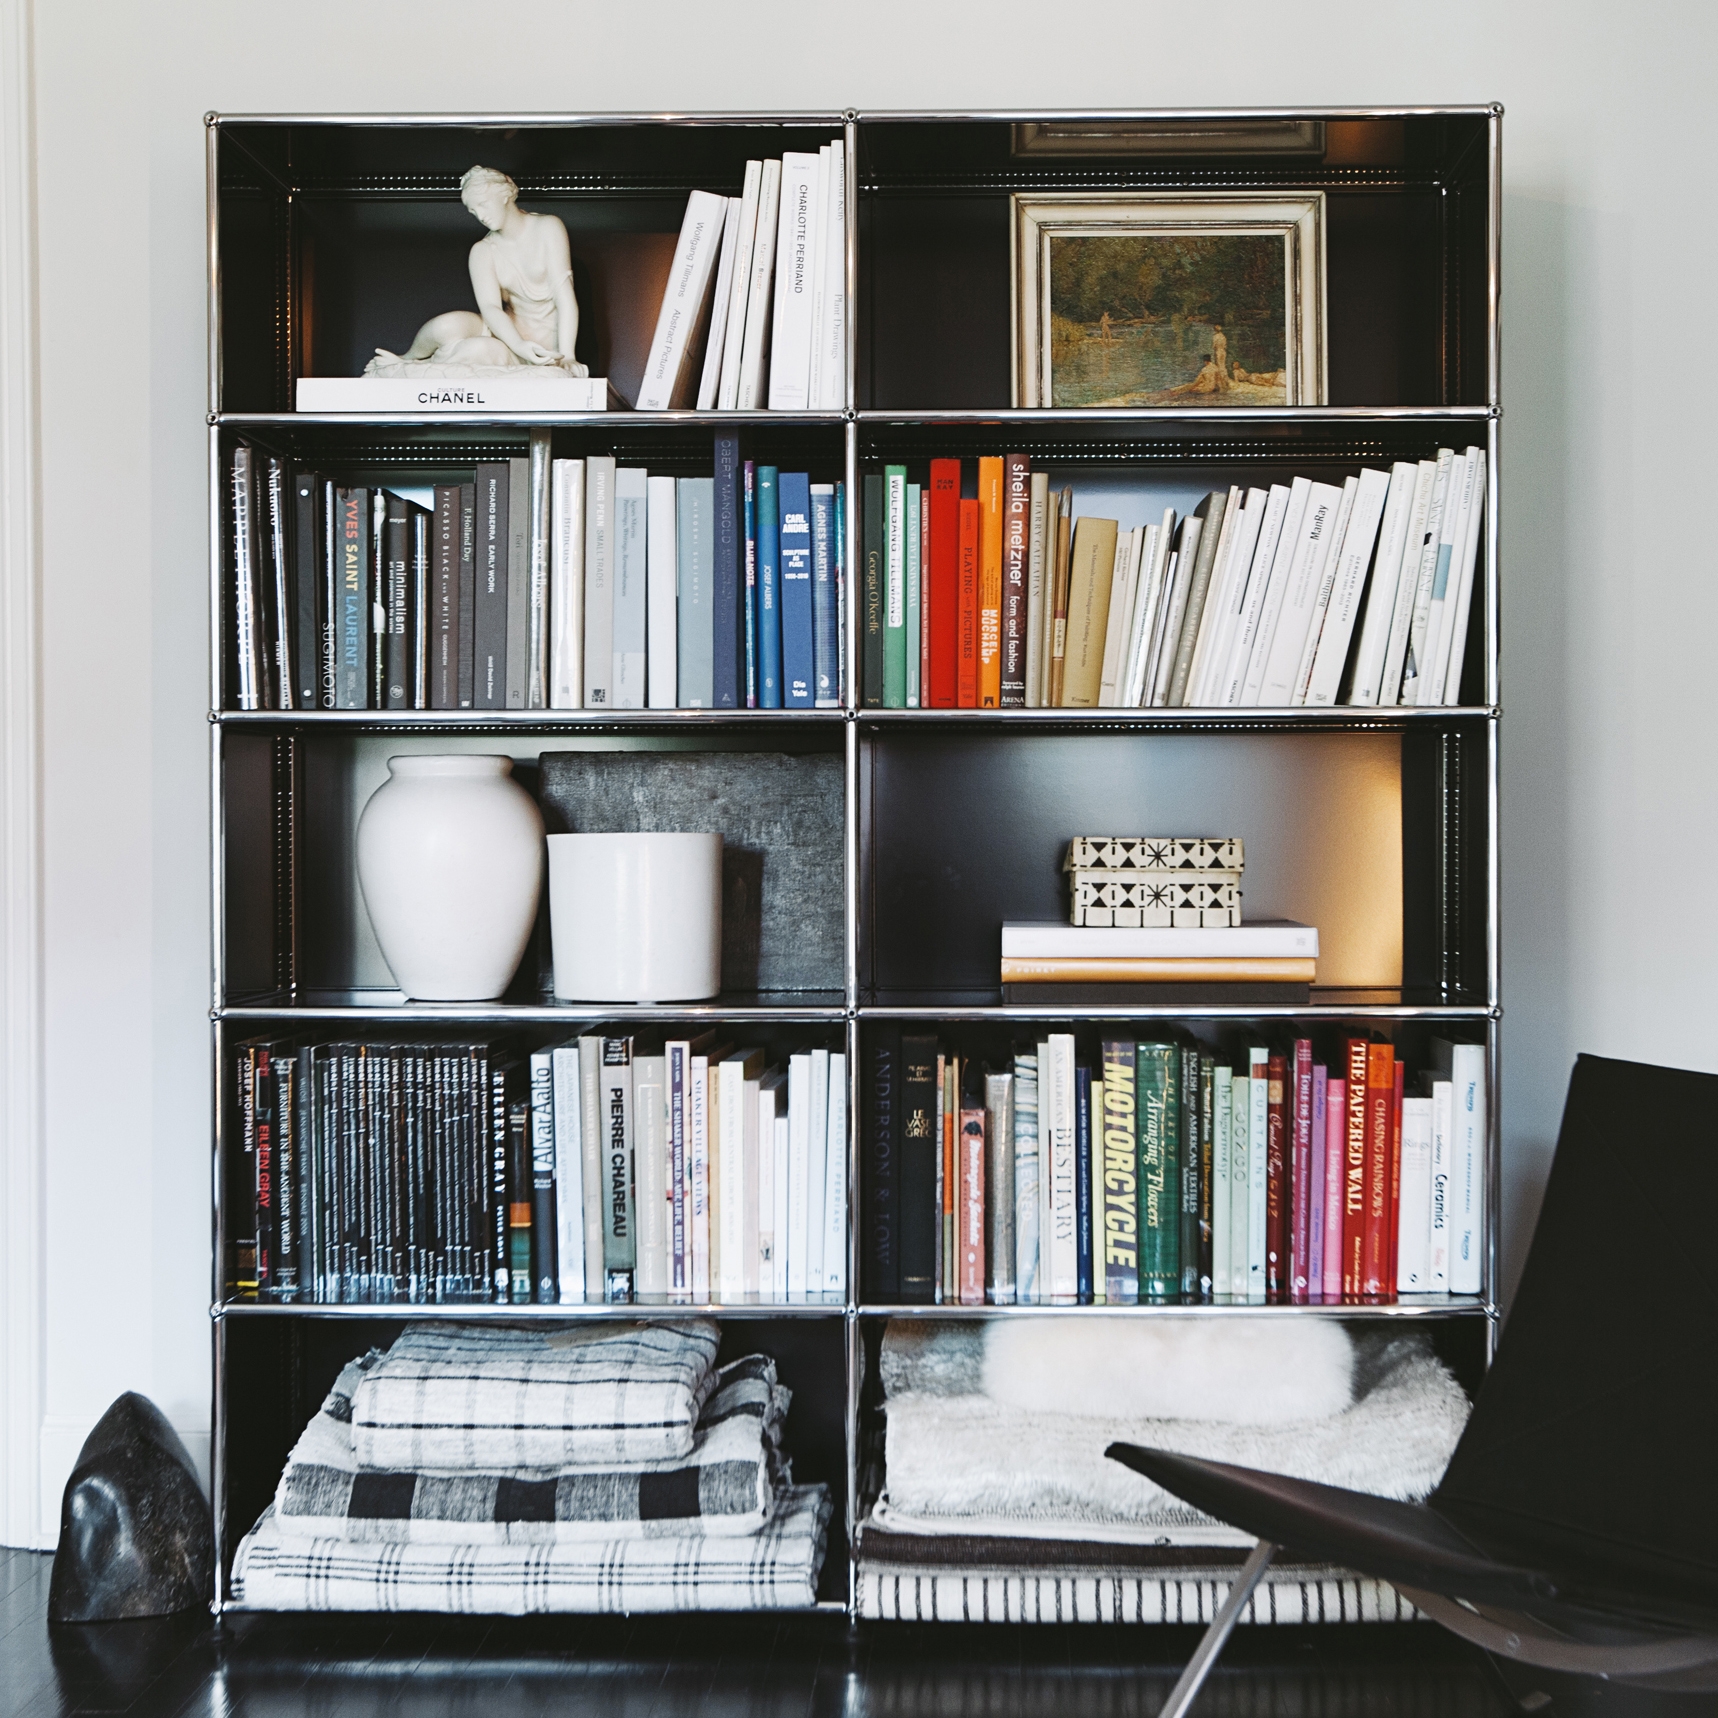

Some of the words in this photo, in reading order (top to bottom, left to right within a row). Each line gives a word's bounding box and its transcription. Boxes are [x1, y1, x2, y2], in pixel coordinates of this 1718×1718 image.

[797, 184, 808, 241] CHARLOTTE
[686, 222, 705, 261] Wolfgang
[677, 264, 694, 298] Tillmans
[794, 244, 805, 294] PERRIAND
[833, 294, 843, 316] Plant
[665, 309, 681, 344] Abstract
[831, 318, 842, 359] Drawings
[656, 346, 672, 380] Pictures
[417, 392, 485, 404] CHANEL
[1437, 453, 1451, 482] YVES
[268, 469, 281, 525] Nukuoro
[596, 472, 605, 501] IRVING
[1012, 464, 1029, 512] sheila
[1419, 473, 1431, 500] Chichu
[345, 500, 358, 538] YVES
[442, 492, 450, 540] PICASSO
[596, 504, 604, 527] PENN
[785, 514, 807, 523] CARL
[817, 505, 826, 539] AGNES
[891, 479, 901, 551] WOLFGANG
[1034, 501, 1042, 536] HARRY
[1271, 498, 1281, 521] HELMUT
[1416, 502, 1426, 515] Art
[1429, 498, 1444, 526] SAINT
[464, 516, 472, 546] Holland
[488, 515, 496, 540] SERRA
[782, 523, 809, 534] ANDRE
[909, 520, 917, 559] LAURENT
[1265, 522, 1276, 548] NEWTON
[1411, 517, 1424, 551] Museum
[345, 544, 358, 590] SAINT
[463, 547, 471, 561] Day
[746, 541, 754, 561] BLUE
[818, 542, 827, 581] MARTIN
[1010, 521, 1024, 586] metzner
[1033, 540, 1041, 597] CALLAHAN
[487, 569, 495, 593] WORK
[746, 563, 754, 585] NOTE
[868, 551, 878, 589] Georgia
[909, 562, 917, 585] SAINT
[963, 547, 972, 593] PLAYING
[1349, 556, 1361, 589] GERHARD
[1419, 550, 1438, 594] LAURENT
[395, 561, 406, 634] minimalism
[764, 586, 772, 609] ALBERS
[890, 558, 901, 624] TILLMANS
[909, 587, 917, 607] YVES
[1009, 596, 1020, 616] form
[1251, 600, 1258, 609] us
[1318, 575, 1332, 607] Balthus
[1341, 593, 1353, 622] RICHTER
[345, 596, 357, 667] LAURENT
[963, 610, 972, 658] PICTURES
[989, 610, 997, 655] MARCEL
[1008, 619, 1019, 637] and
[1242, 625, 1253, 644] them
[1247, 610, 1255, 624] and
[981, 610, 990, 664] DUCHAMP
[322, 623, 335, 707] SUGIMOTO
[1007, 640, 1019, 672] fashion
[1001, 696, 1024, 704] ARENA
[1229, 680, 1238, 703] TASCHEN
[244, 1057, 252, 1091] JOSEF
[1055, 1051, 1063, 1065] AN
[1189, 1052, 1198, 1091] ENGLISH
[1351, 1043, 1366, 1081] THE
[557, 1054, 565, 1117] ARCHITECTURE
[566, 1069, 574, 1111] JAPANESE
[694, 1080, 702, 1126] SHAKER
[1055, 1068, 1064, 1124] AMERICAN
[1221, 1082, 1231, 1102] The
[1301, 1073, 1311, 1101] TOILE
[244, 1095, 252, 1152] HOFFMANN
[279, 1082, 289, 1135] FURNITURE
[493, 1077, 504, 1141] EILEEN
[611, 1088, 624, 1149] PIERRE
[874, 1047, 890, 1177] ANDERSON
[906, 1118, 932, 1128] VASE
[912, 1109, 924, 1118] LE
[1301, 1104, 1309, 1117] DE
[1348, 1084, 1365, 1165] PAPERED
[1373, 1099, 1386, 1153] CHASING
[279, 1138, 288, 1150] IN
[567, 1113, 575, 1143] HOUSE
[835, 1099, 844, 1167] CHARLOTTE
[904, 1128, 932, 1138] GREC
[1143, 1091, 1163, 1165] Arranging
[1189, 1113, 1198, 1167] AMERICAN
[1217, 1106, 1230, 1181] Daguerreotype
[1255, 1085, 1264, 1189] CURTAINS
[1298, 1120, 1310, 1144] JOUY
[258, 1125, 270, 1170] EILEEN
[279, 1152, 289, 1171] THE
[695, 1130, 703, 1177] VILLAGE
[1105, 1062, 1136, 1268] MOTORCYCLE
[1168, 1145, 1175, 1162] OF
[1328, 1150, 1340, 1177] Living
[494, 1147, 505, 1194] GRAY
[1021, 1124, 1033, 1221] COLLECTED
[1056, 1128, 1072, 1245] BESTIARY
[1329, 1180, 1338, 1193] in
[1372, 1154, 1384, 1218] RAINBOWS
[259, 1172, 270, 1208] GRAY
[280, 1173, 289, 1215] ANCIENT
[612, 1153, 626, 1237] CHAREAU
[695, 1180, 703, 1216] VIEWS
[833, 1174, 842, 1233] PERRIAND
[875, 1189, 890, 1202] &
[1147, 1171, 1164, 1228] Flowers
[1189, 1171, 1198, 1213] TEXTILES
[1347, 1168, 1362, 1215] WALL
[1434, 1174, 1449, 1228] Ceramics
[1328, 1195, 1338, 1230] Mexico
[280, 1219, 290, 1253] WORLD
[874, 1214, 890, 1264] LOW
